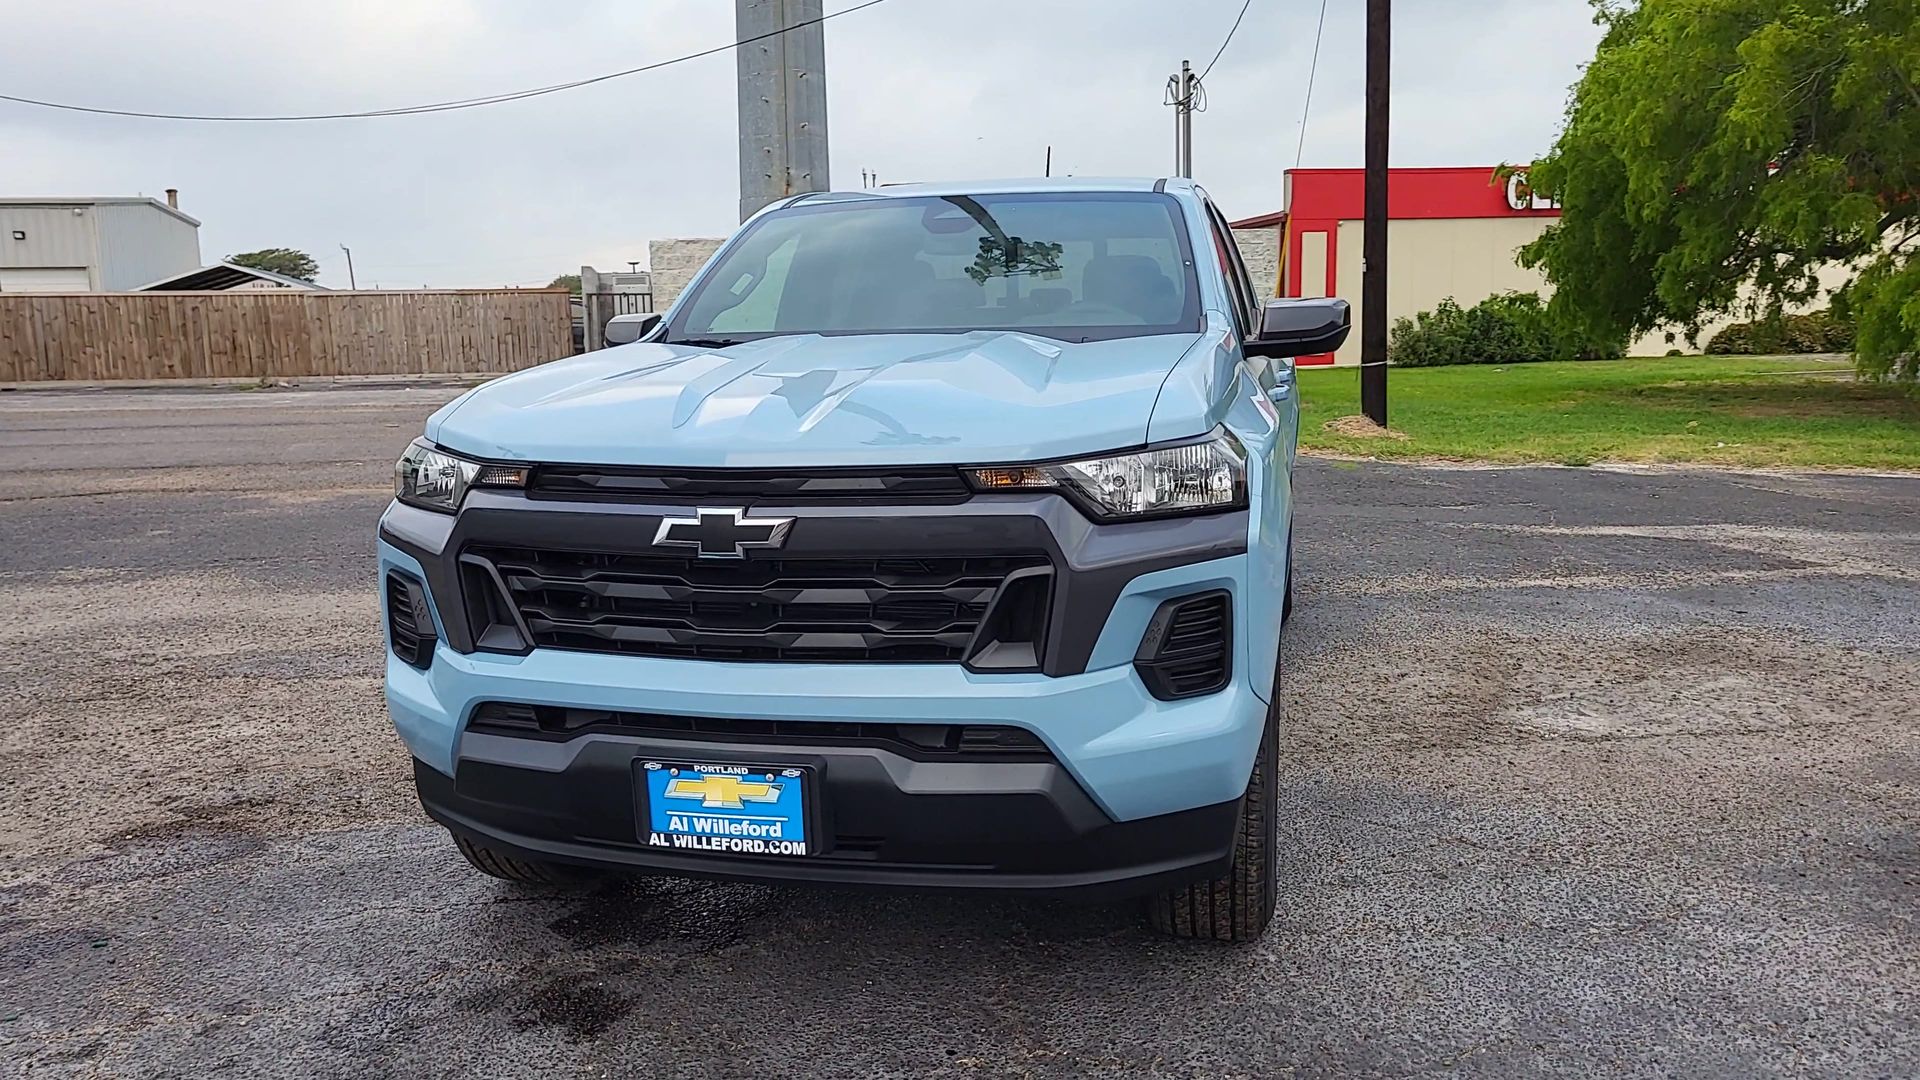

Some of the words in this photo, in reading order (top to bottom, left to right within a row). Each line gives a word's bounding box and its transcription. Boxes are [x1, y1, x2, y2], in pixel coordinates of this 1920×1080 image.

[694, 765, 749, 775] PORTLAND
[669, 816, 688, 831] Al
[693, 817, 782, 837] Willeford
[650, 833, 669, 847] AL
[673, 835, 806, 855] WILLEFORD.COM
